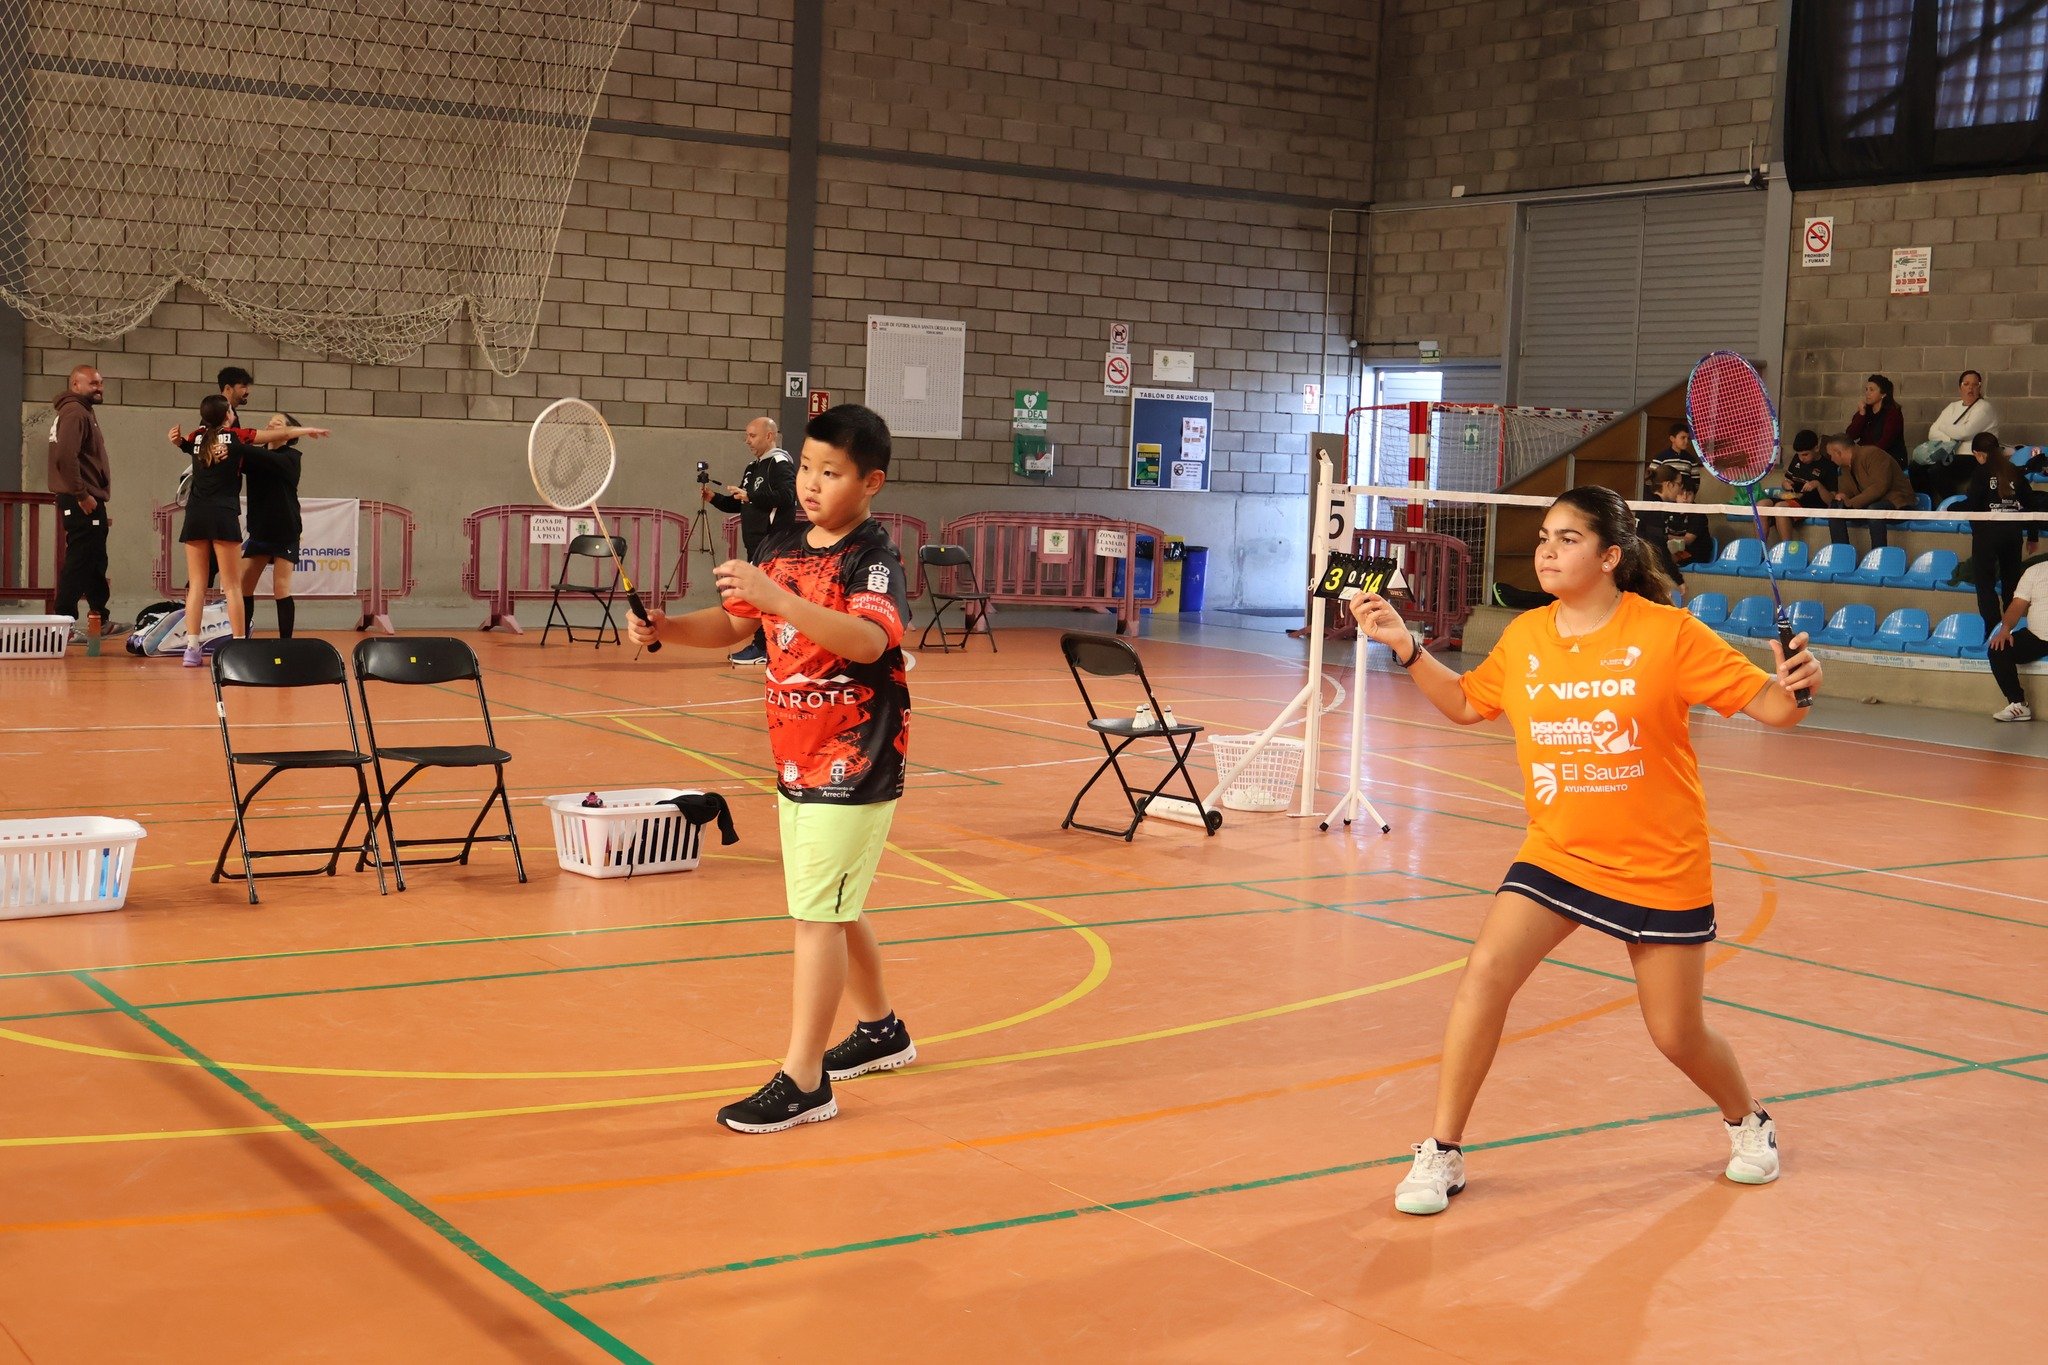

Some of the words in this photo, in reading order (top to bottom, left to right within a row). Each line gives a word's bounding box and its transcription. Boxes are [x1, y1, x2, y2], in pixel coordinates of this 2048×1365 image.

[1027, 411, 1044, 419] DEA
[1329, 500, 1345, 539] 5
[1096, 539, 1126, 547] LLAMADA
[299, 548, 351, 556] ANARIAS
[1325, 568, 1344, 591] 3
[1548, 679, 1636, 700] VICTOR
[766, 689, 856, 709] ZAROTE
[1537, 733, 1592, 745] camina
[1562, 763, 1578, 780] El
[1584, 760, 1645, 781] Sauzal
[1564, 784, 1628, 793] AYUNTAMIENTO
